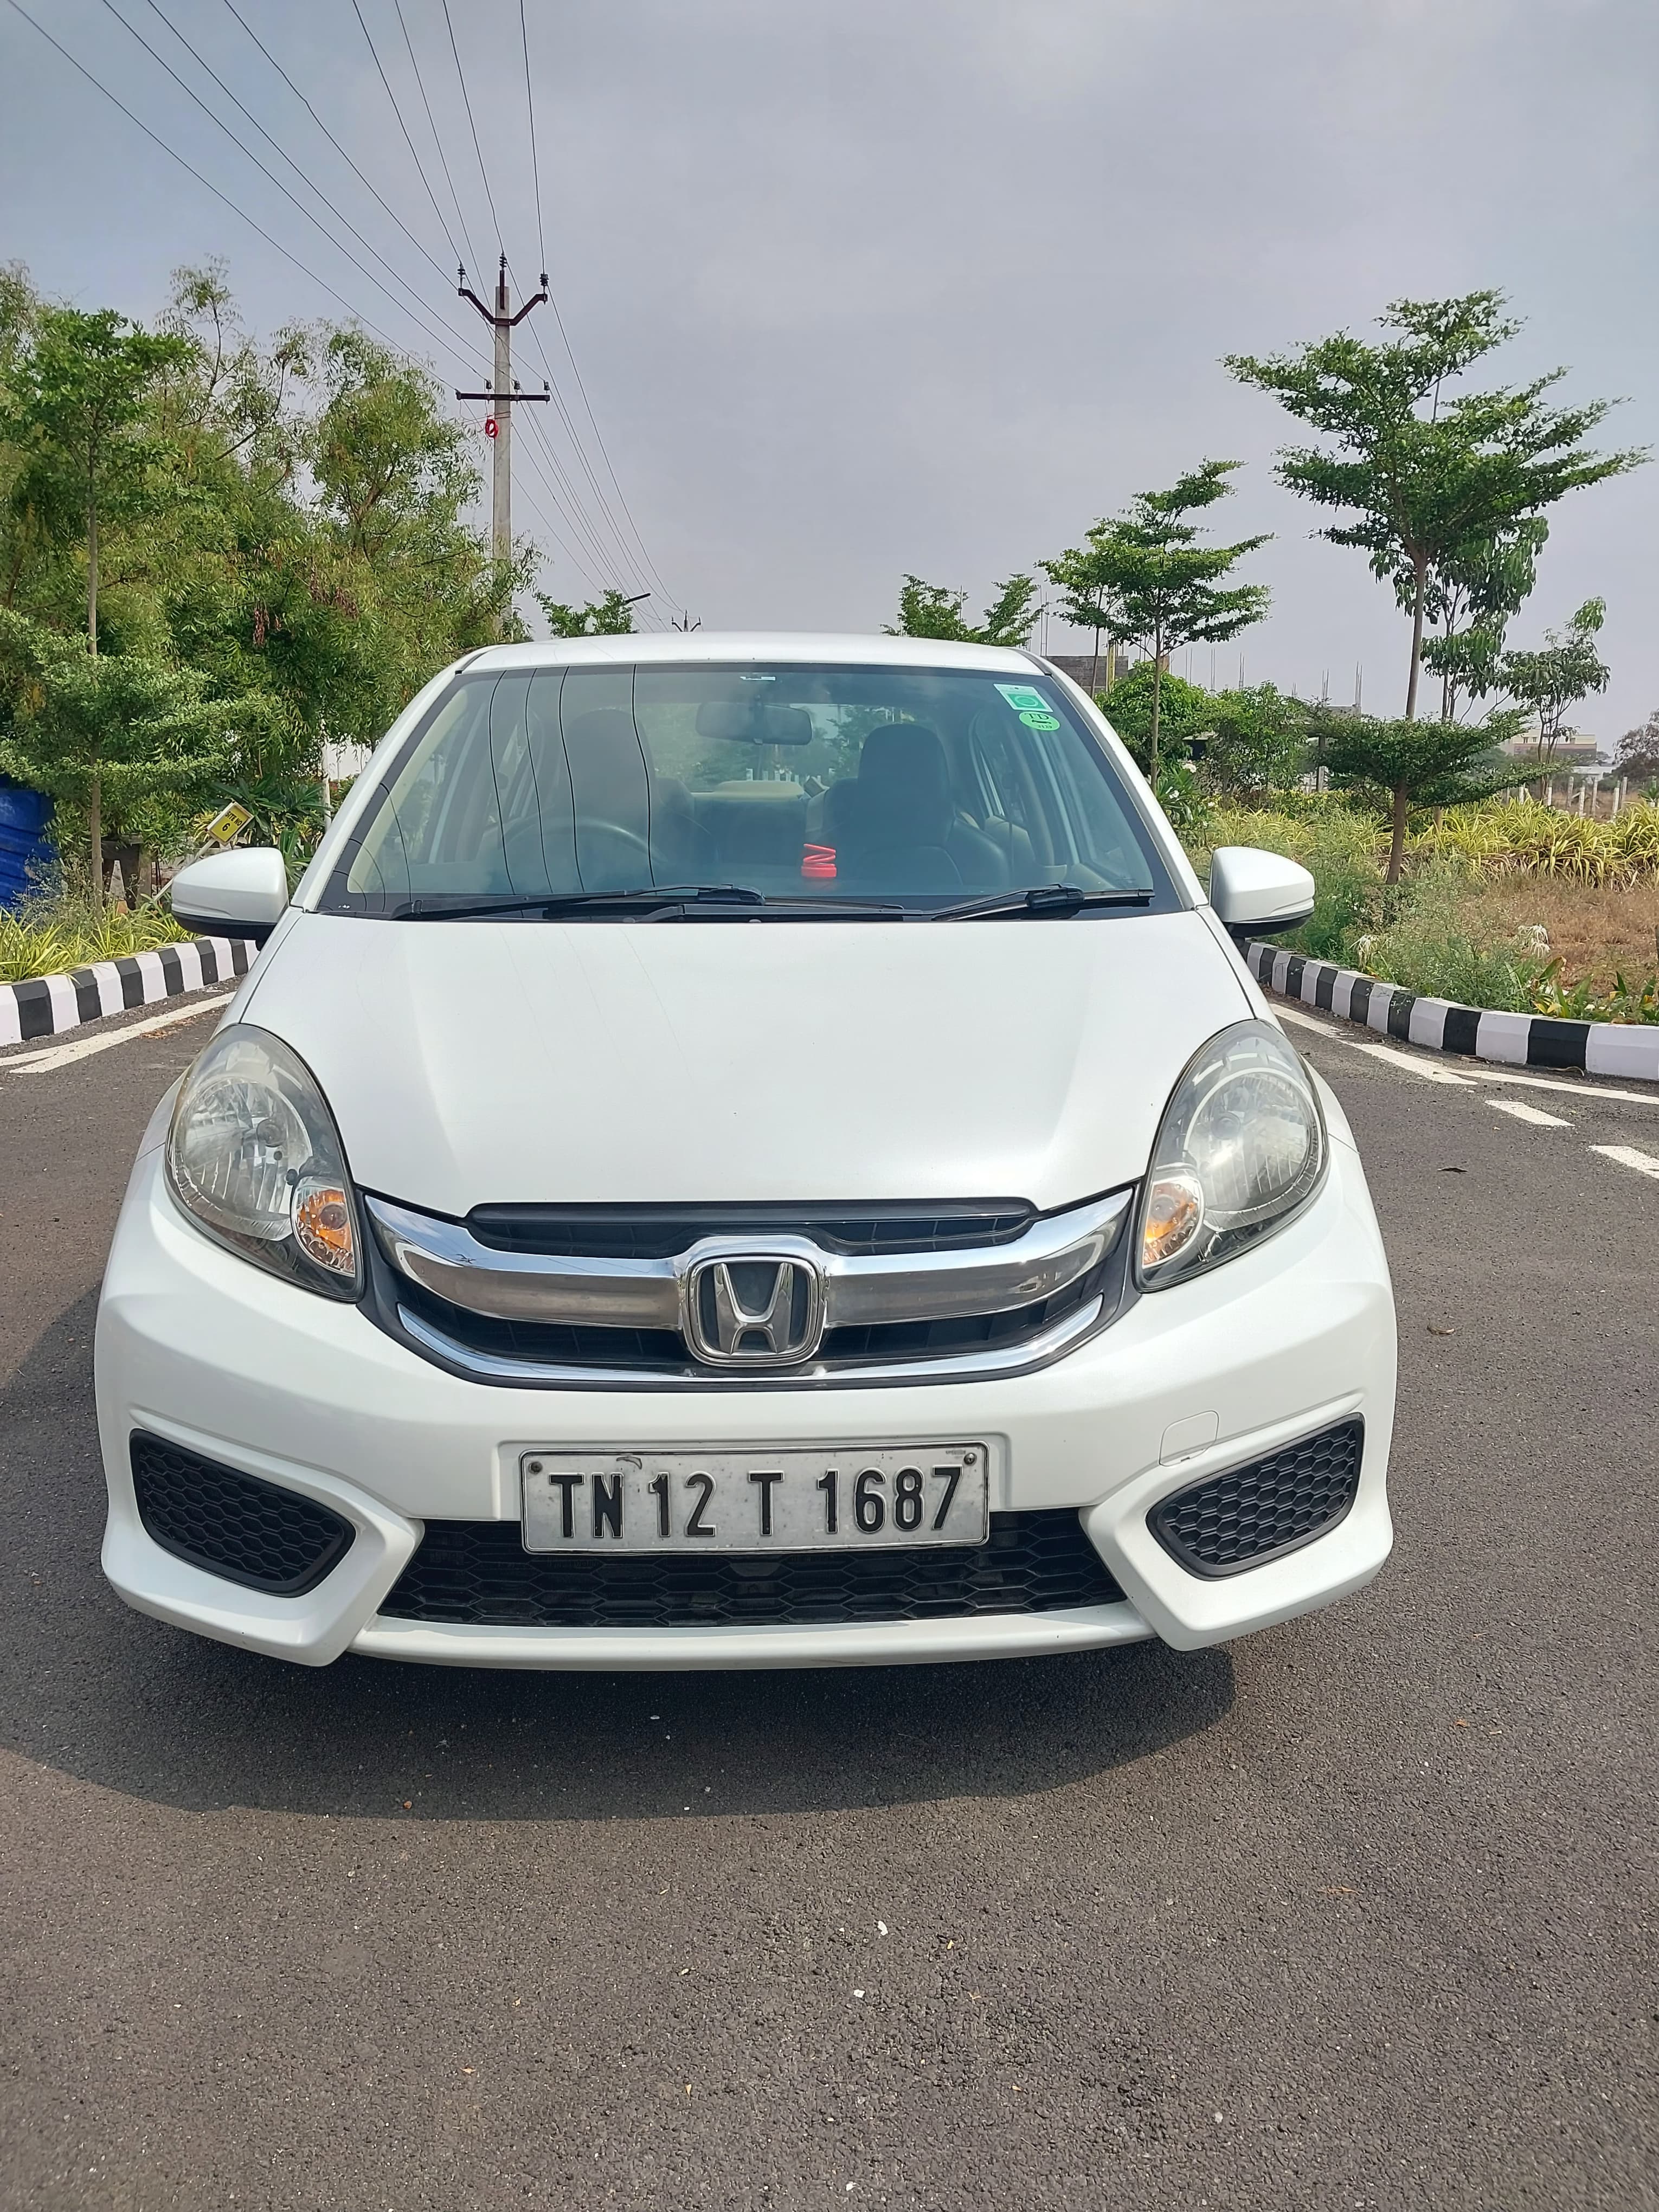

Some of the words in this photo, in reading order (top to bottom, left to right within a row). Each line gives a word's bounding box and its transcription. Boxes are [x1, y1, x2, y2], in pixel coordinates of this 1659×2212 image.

[226, 811, 237, 821] SITE
[234, 818, 242, 826] NO
[222, 823, 230, 831] 6
[549, 1472, 624, 1539] TN
[648, 1471, 717, 1537] 12
[747, 1470, 785, 1536] T
[816, 1465, 964, 1535] 1687
